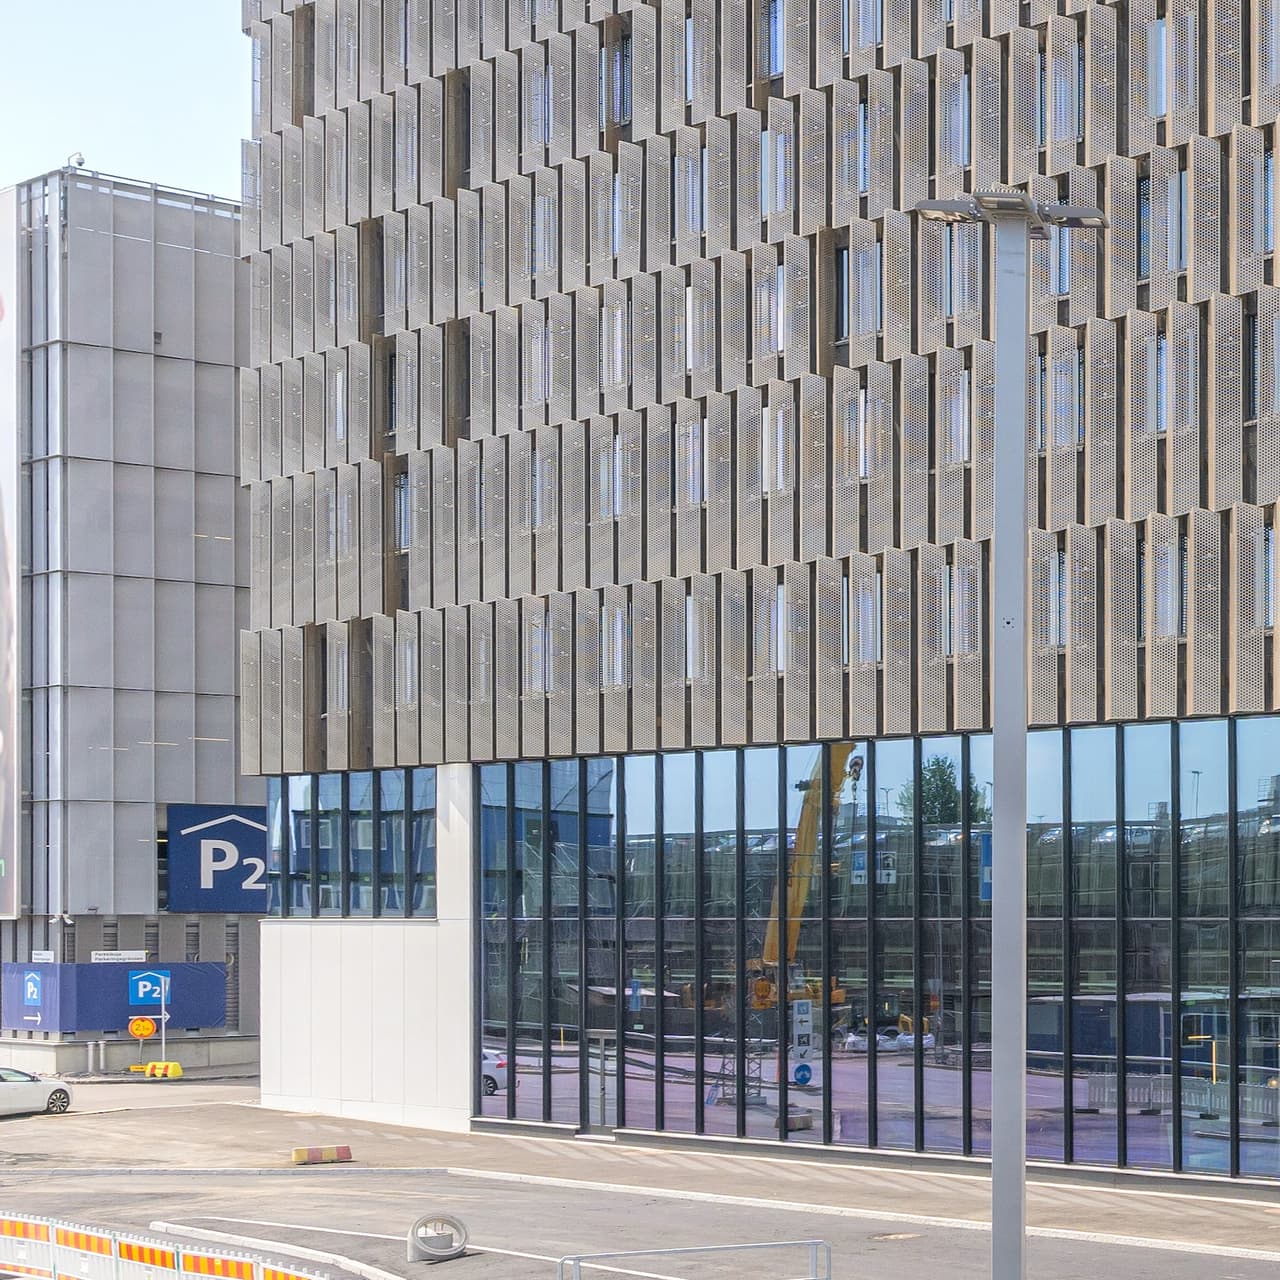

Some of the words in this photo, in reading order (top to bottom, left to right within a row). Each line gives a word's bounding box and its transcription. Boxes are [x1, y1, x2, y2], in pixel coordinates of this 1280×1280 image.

[200, 839, 267, 890] P2
[27, 981, 38, 999] P2
[138, 981, 161, 998] P2
